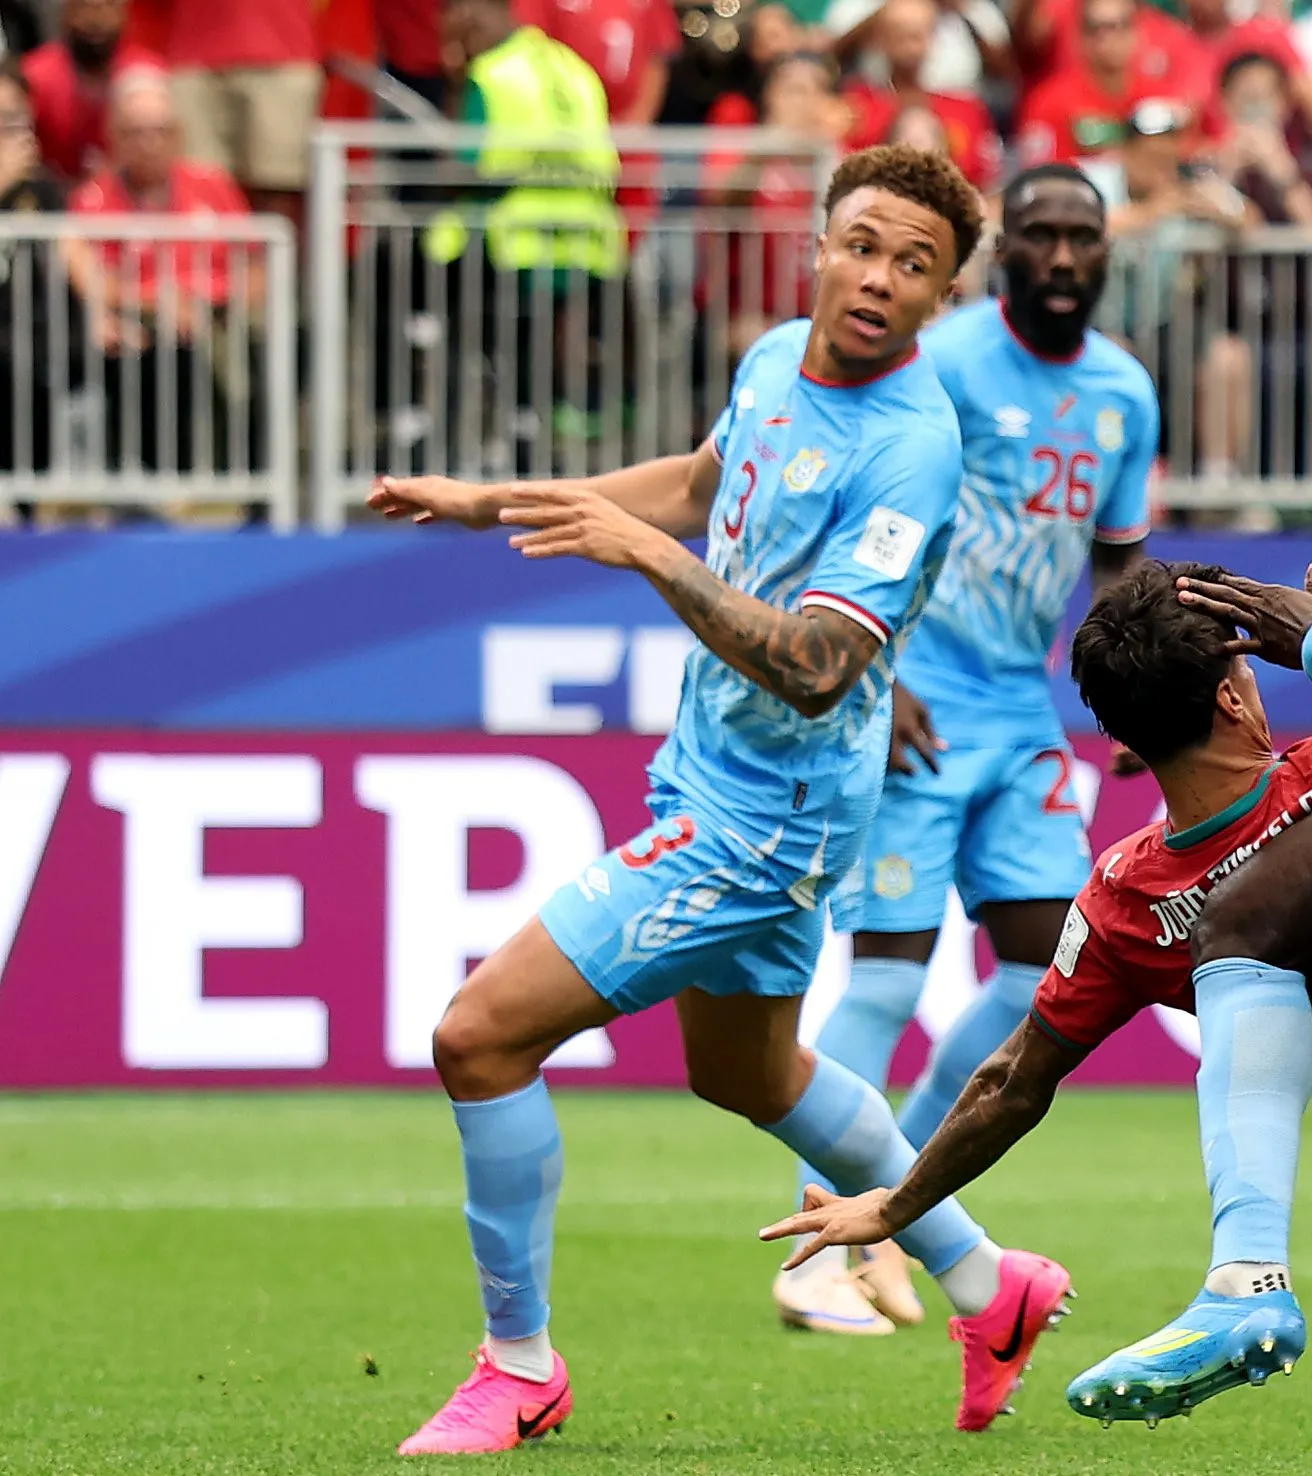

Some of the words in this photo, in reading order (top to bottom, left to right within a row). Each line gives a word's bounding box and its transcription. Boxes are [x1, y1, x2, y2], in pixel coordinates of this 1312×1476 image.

[723, 460, 757, 539] 3
[1026, 445, 1099, 521] 26
[618, 813, 697, 870] 3
